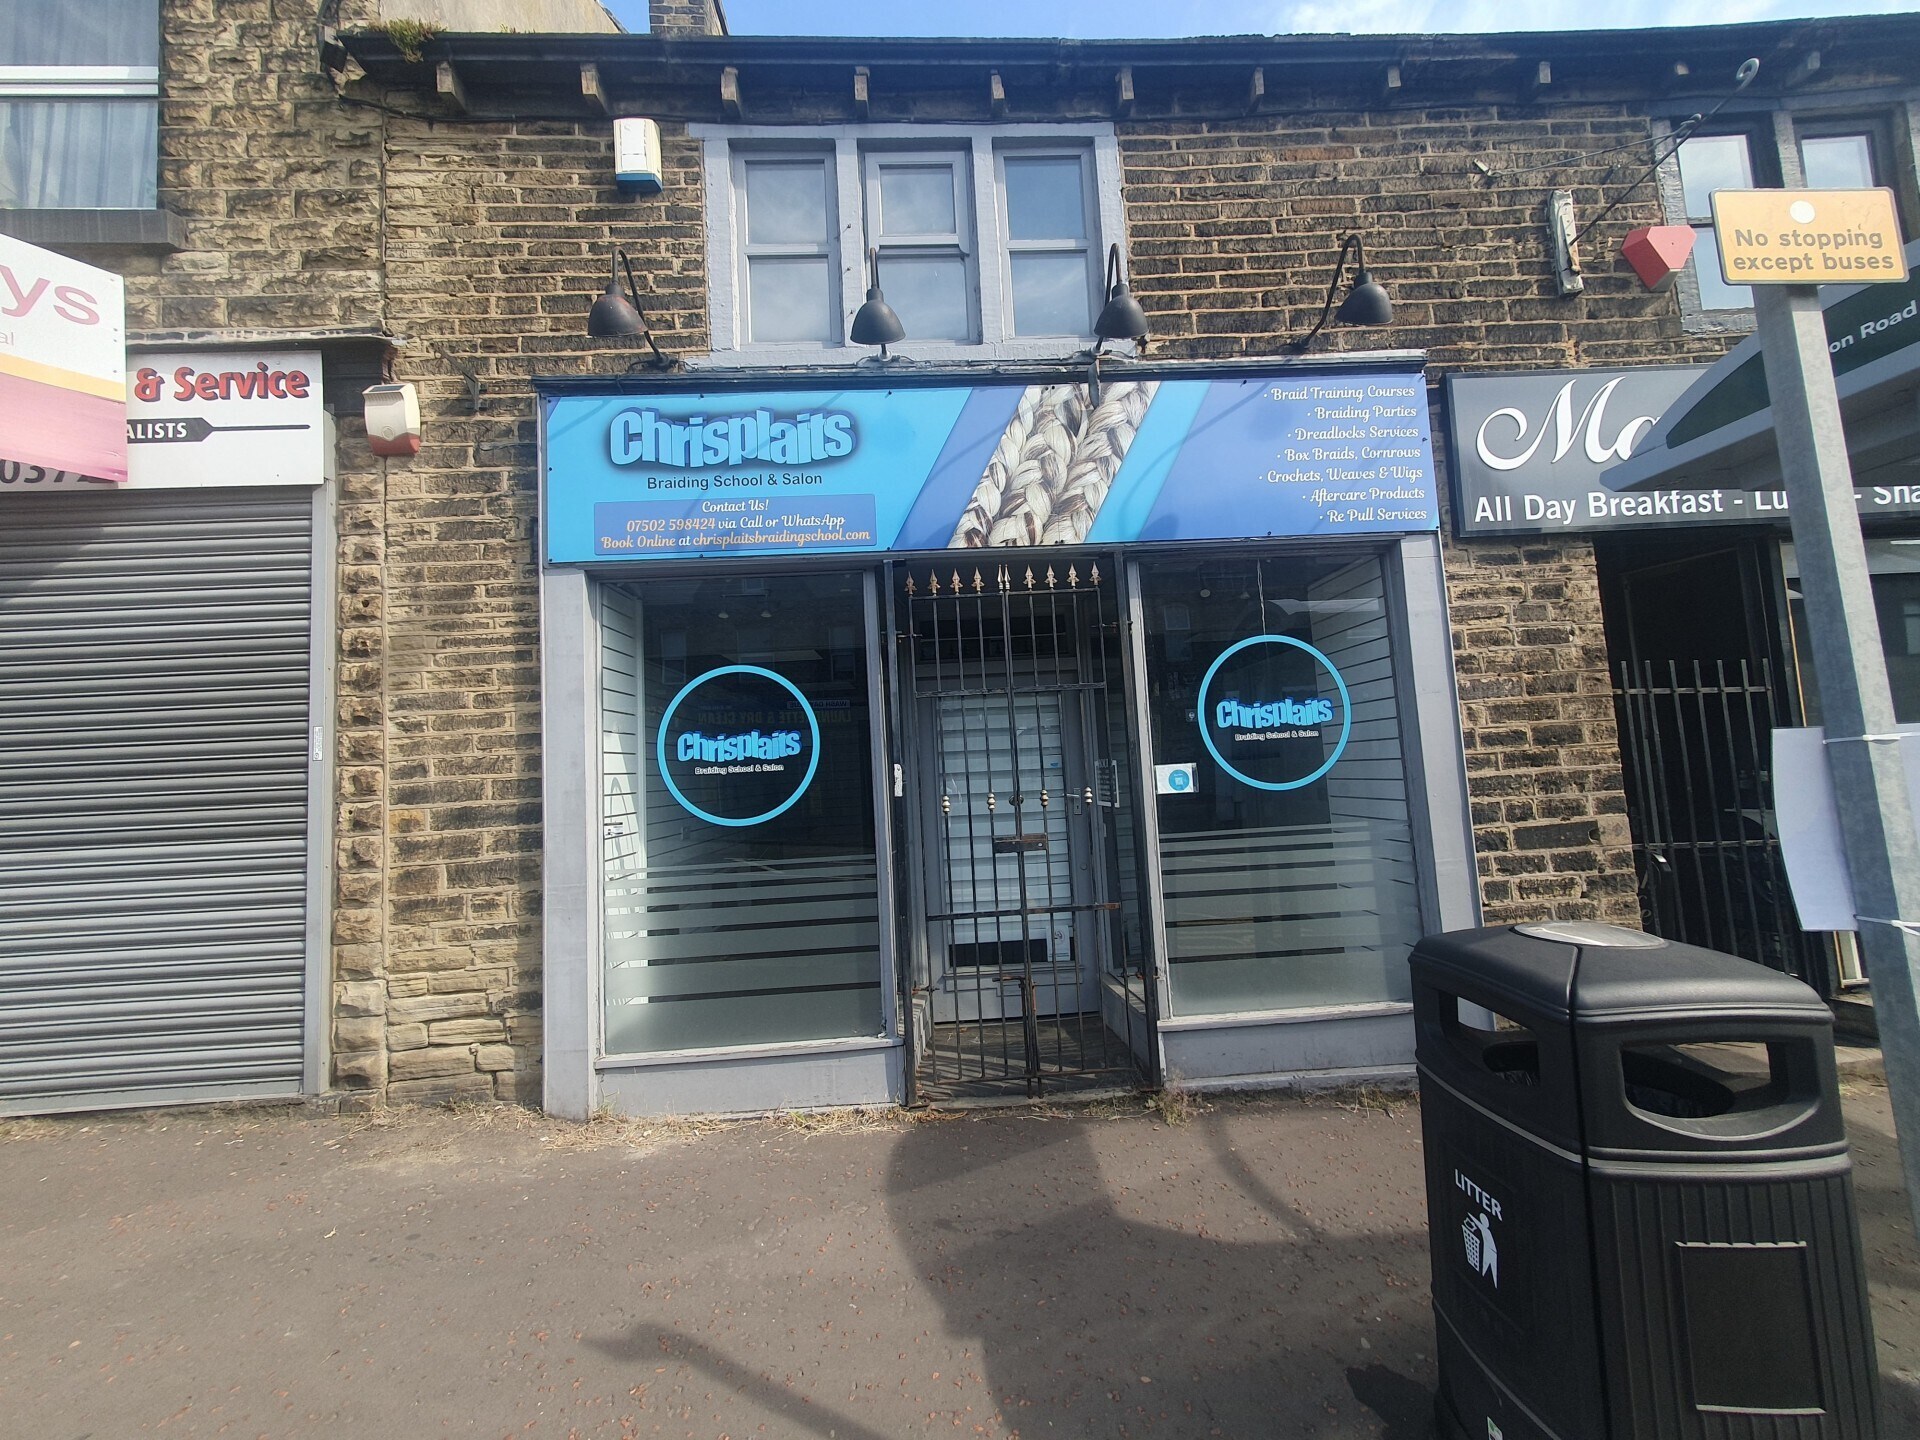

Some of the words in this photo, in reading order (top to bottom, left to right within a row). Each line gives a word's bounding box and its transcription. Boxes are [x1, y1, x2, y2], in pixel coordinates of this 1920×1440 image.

[1735, 230, 1769, 247] No
[1779, 228, 1884, 250] stopping
[1733, 254, 1814, 273] except
[1823, 252, 1895, 271] buses
[1860, 300, 1917, 339] Road
[134, 367, 166, 402] &
[173, 361, 311, 401] Service
[1271, 387, 1308, 400] Braid
[1310, 386, 1364, 402] Training
[1367, 385, 1415, 397] Courses
[1314, 406, 1370, 422] Braiding
[1372, 405, 1417, 417] Parties
[610, 407, 856, 467] Chrisplaits
[1294, 426, 1366, 441] Dreadlocks
[1369, 425, 1419, 438] Services
[1284, 448, 1310, 462] Box
[1312, 447, 1358, 461] Braids,
[1361, 446, 1421, 459] Cornrows
[647, 476, 709, 491] Braiding
[713, 473, 763, 487] School
[767, 474, 778, 486] &
[782, 472, 823, 486] Salon
[1267, 469, 1324, 483] Crochets,
[1326, 467, 1375, 481] Weaves
[1379, 467, 1388, 479] &
[1390, 466, 1423, 483] Wigs
[702, 500, 746, 513] Contact
[748, 499, 769, 511] Us!
[1309, 488, 1367, 506] Aftercare
[1368, 486, 1425, 500] Products
[1327, 509, 1345, 522] Re
[1347, 508, 1374, 522] Pull
[1377, 507, 1427, 521] Services
[1475, 495, 1512, 522] All
[1524, 494, 1576, 524] Day
[1588, 490, 1723, 517] Breakfast
[626, 519, 665, 532] 07502
[668, 518, 715, 531] 598424
[718, 518, 737, 529] via
[740, 515, 762, 528] Call
[765, 518, 778, 527] or
[781, 513, 846, 530] WhatsApp
[601, 535, 634, 549] Book
[637, 534, 676, 547] Online
[678, 536, 691, 546] at
[693, 528, 870, 549] chrisplaitsbraidingschool.com
[1216, 697, 1334, 729] Chrisplaits
[677, 730, 802, 762] Chrisplaits
[1454, 1168, 1503, 1221] LITTER
